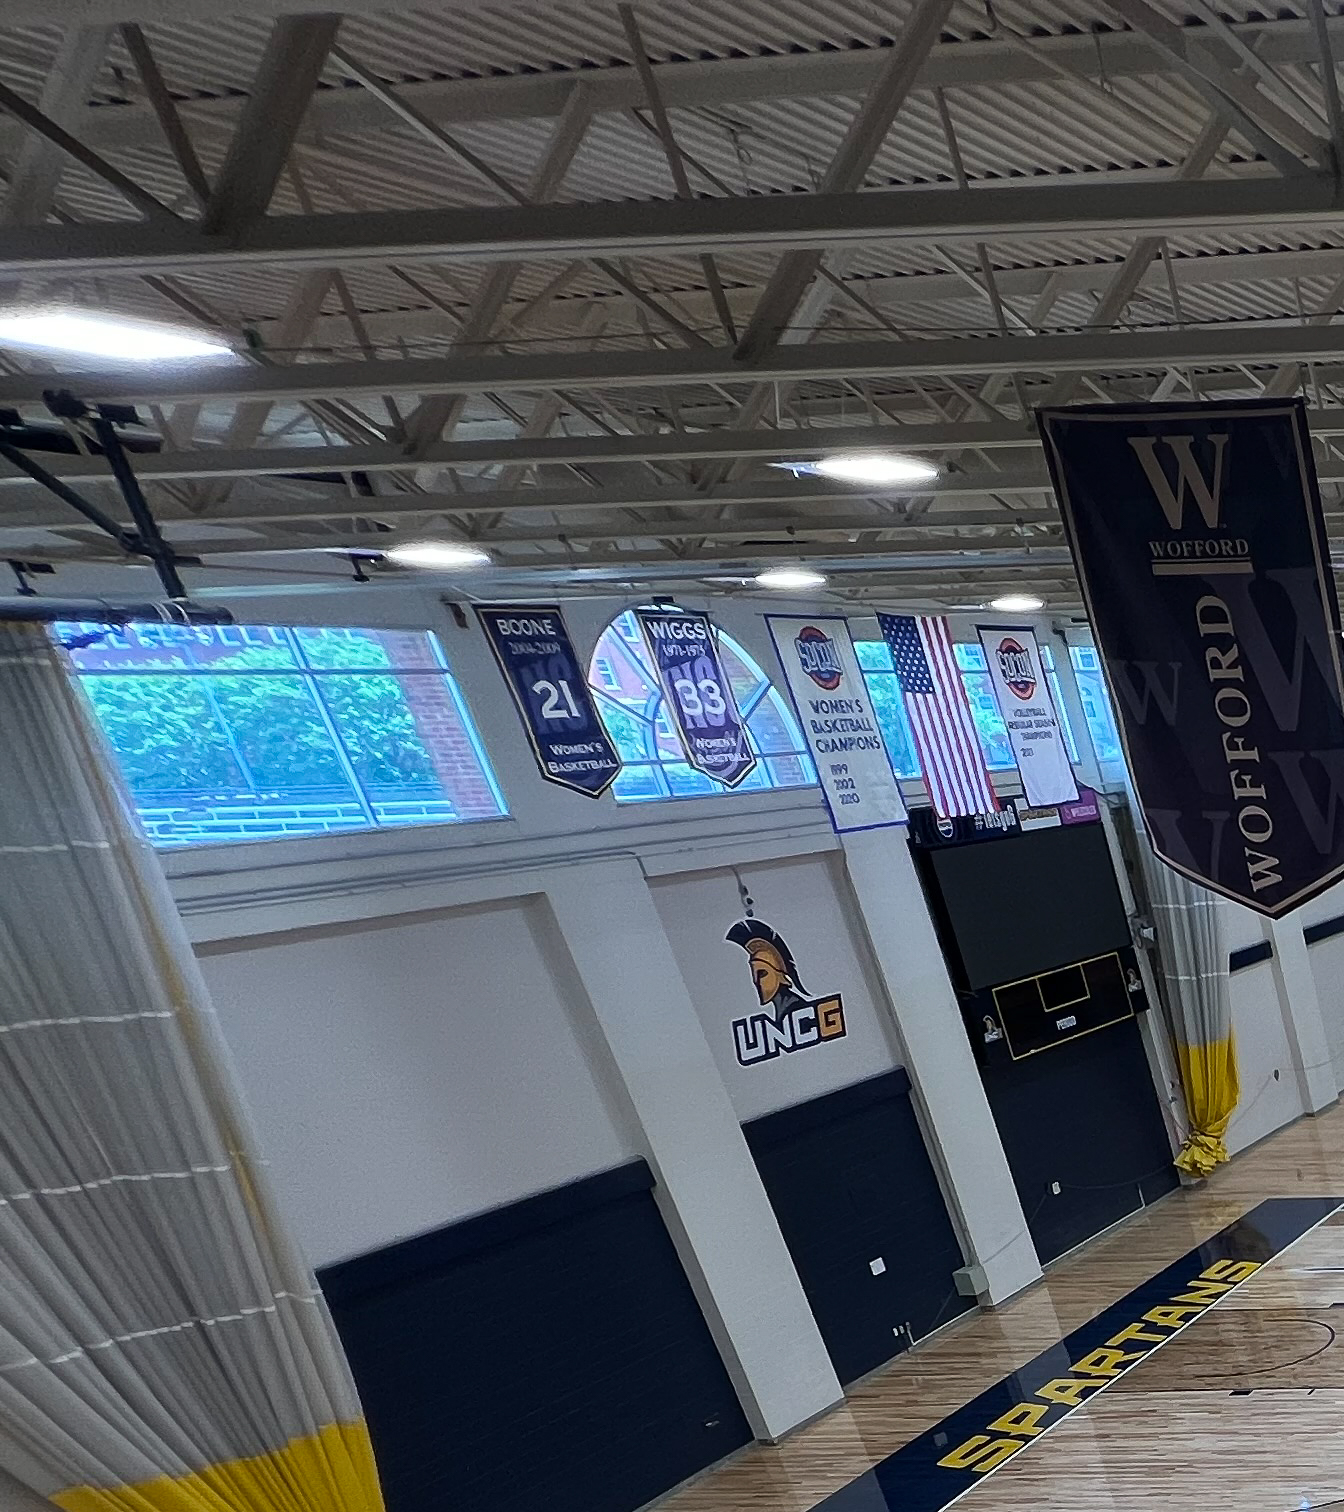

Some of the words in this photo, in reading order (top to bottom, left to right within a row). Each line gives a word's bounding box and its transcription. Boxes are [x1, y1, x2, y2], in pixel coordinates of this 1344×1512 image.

[1128, 433, 1231, 530] W
[1148, 538, 1249, 558] WOFFORD
[496, 619, 556, 636] BOONE
[647, 621, 707, 640] WIGGS
[531, 679, 580, 719] 21
[674, 678, 726, 716] 33
[808, 699, 863, 714] WOMEN'S
[811, 718, 873, 734] BASKETBALL
[549, 742, 604, 756] WOMEN'S
[816, 735, 880, 753] CHAMPIONS
[1196, 594, 1283, 893] WOFFORD
[547, 758, 618, 774] BASKETBALL
[734, 996, 845, 1063] UNCG
[937, 1258, 1262, 1473] SPARTANS
